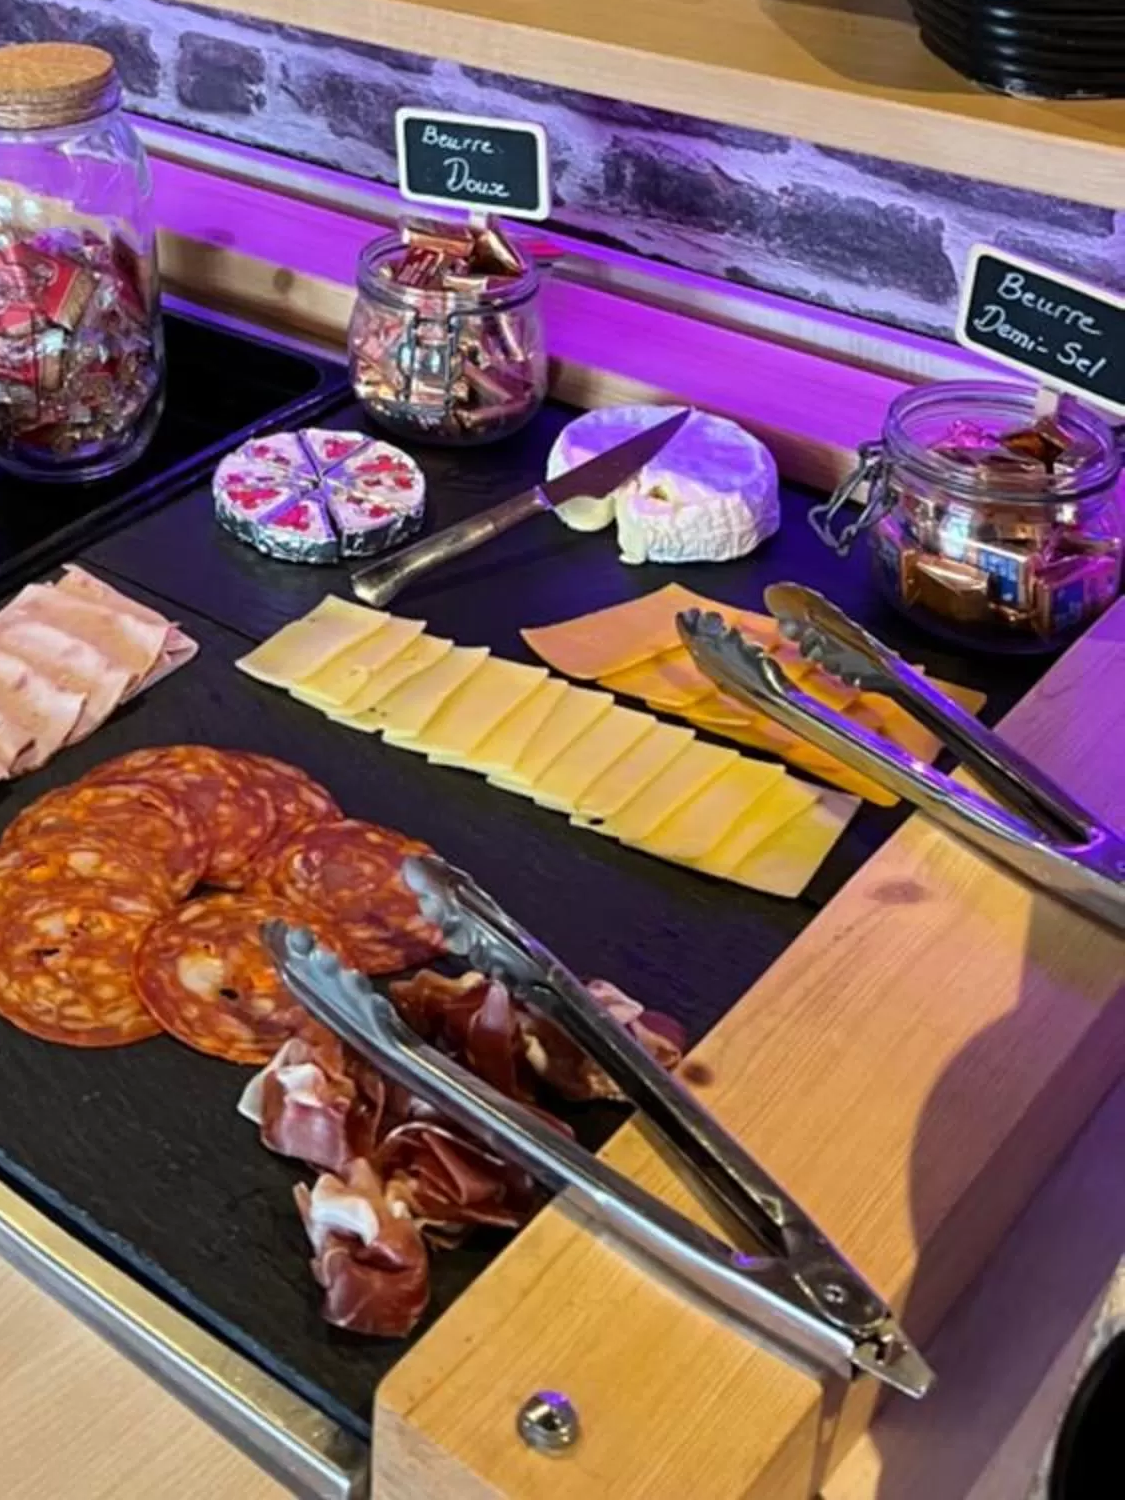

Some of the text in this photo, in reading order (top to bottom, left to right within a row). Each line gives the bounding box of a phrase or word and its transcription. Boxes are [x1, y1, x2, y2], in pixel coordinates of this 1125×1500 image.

[422, 125, 495, 154] Beurre
[443, 157, 510, 197] Doux
[997, 272, 1103, 336] Beurre
